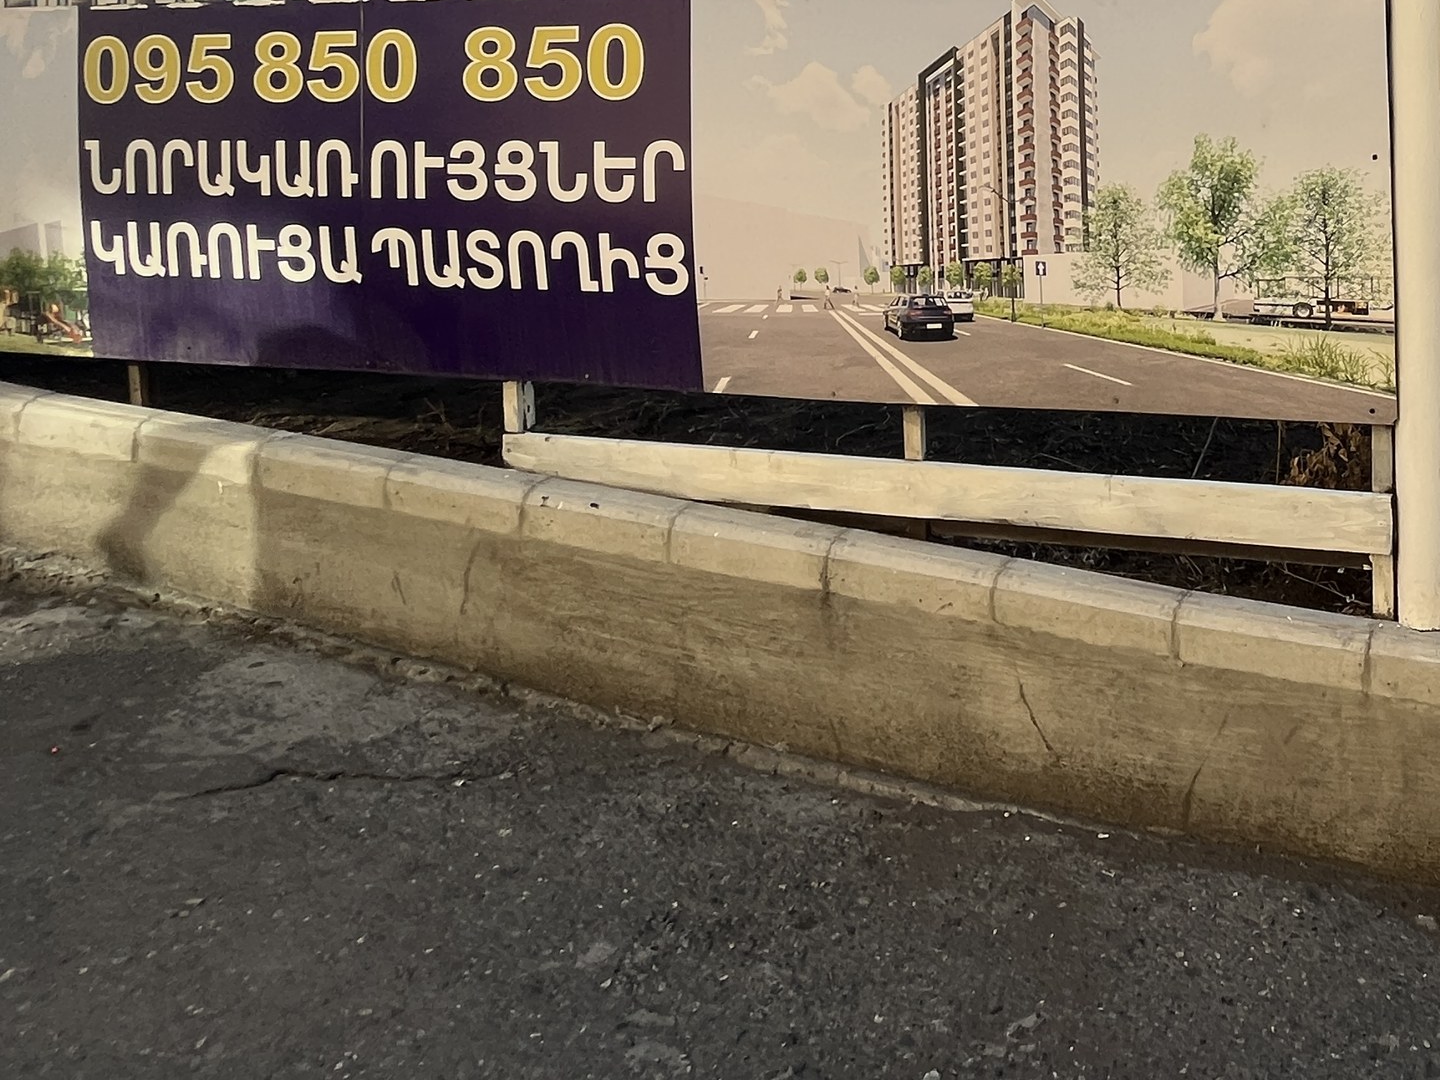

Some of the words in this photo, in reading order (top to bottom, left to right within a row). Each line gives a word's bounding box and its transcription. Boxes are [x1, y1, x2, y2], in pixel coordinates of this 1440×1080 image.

[83, 32, 235, 104] 095
[252, 27, 418, 103] 850
[461, 22, 646, 103] 850
